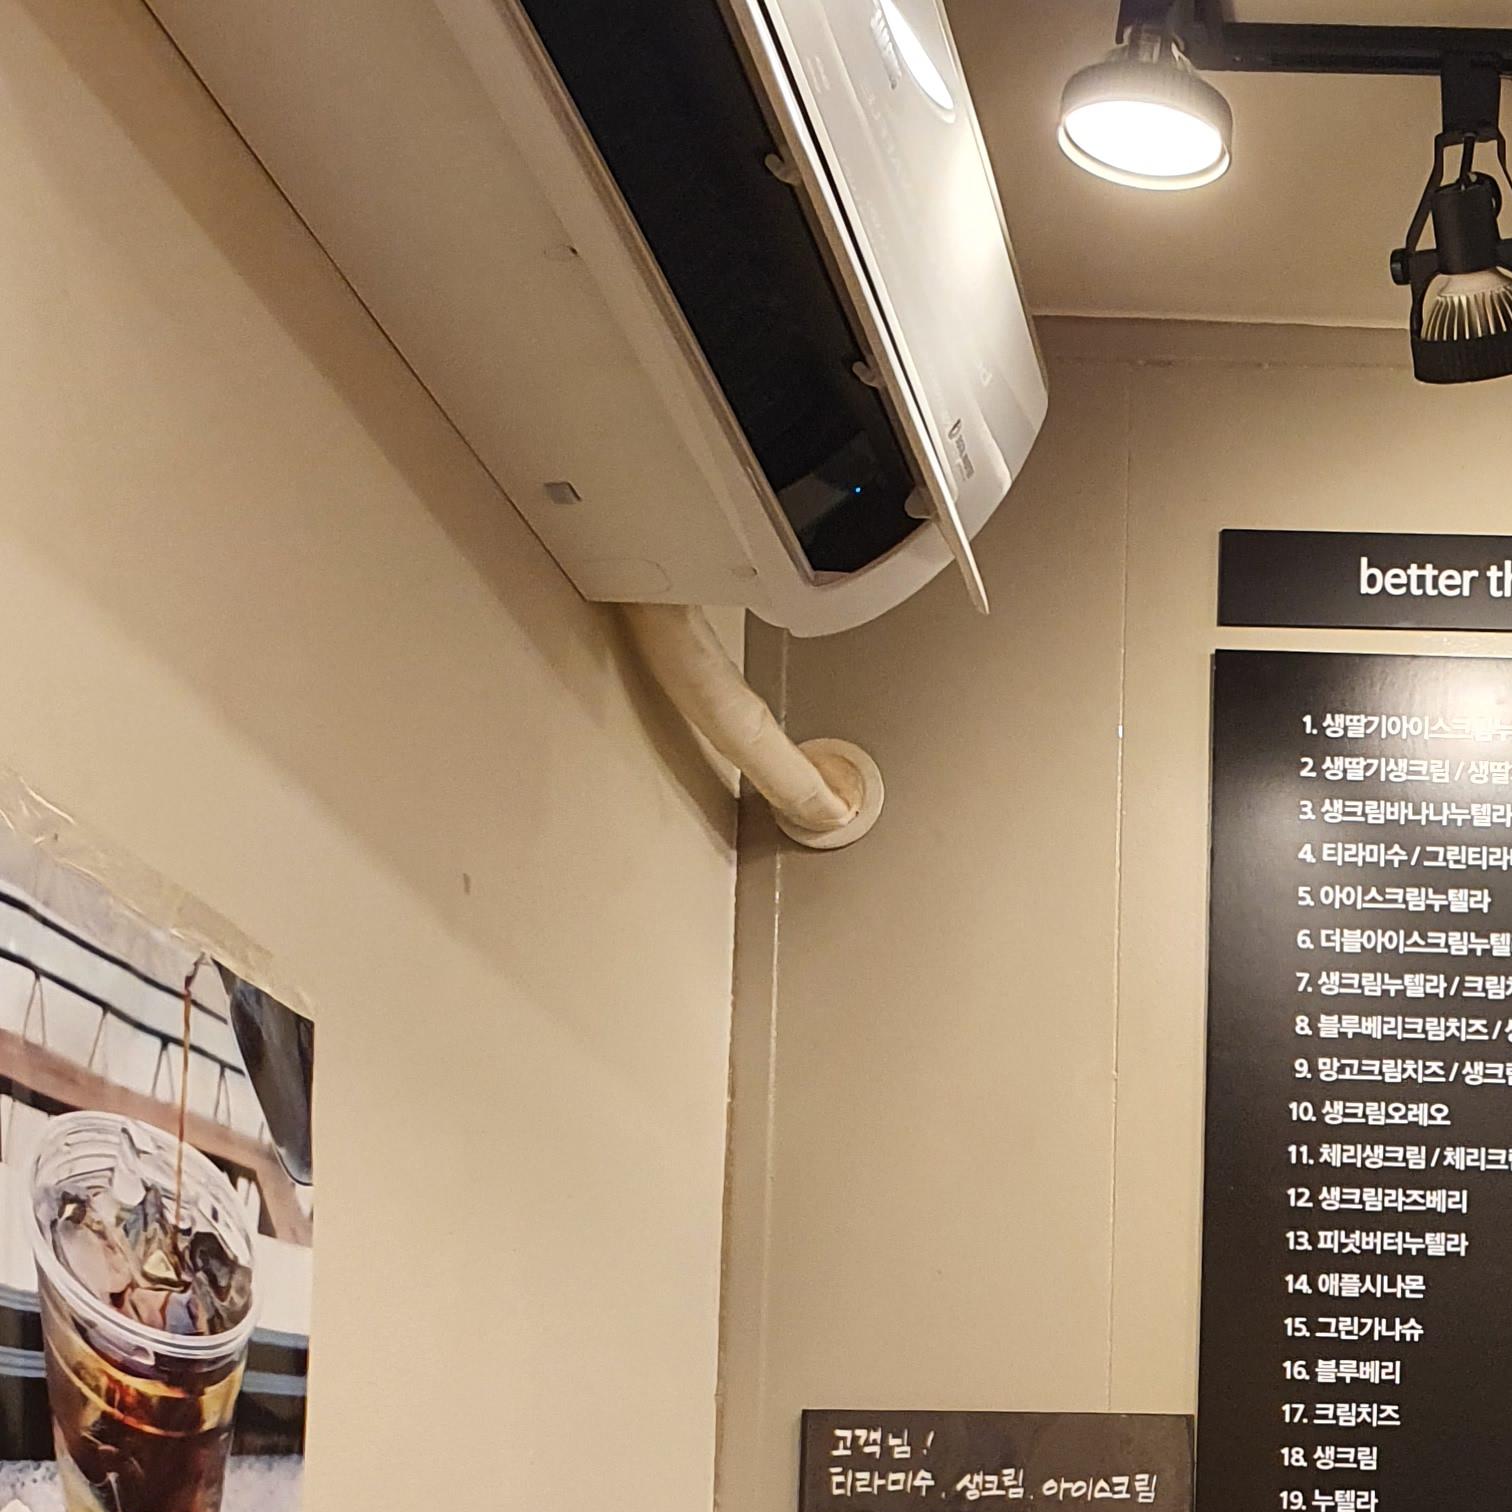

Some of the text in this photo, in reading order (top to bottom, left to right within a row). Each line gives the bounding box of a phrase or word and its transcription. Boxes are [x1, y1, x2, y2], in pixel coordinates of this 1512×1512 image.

[1360, 556, 1479, 597] better
[1321, 756, 1450, 783] 생딸기생크림
[1321, 842, 1409, 868] 티라미수
[1319, 884, 1492, 914] 아이스크림누텔라
[1317, 971, 1448, 999] 생크림누텔라
[1317, 1014, 1489, 1042] 블루베리크림치즈
[1317, 1057, 1447, 1084] 망고크림치즈
[1321, 1100, 1451, 1127] 생크림오레오
[1319, 1143, 1426, 1170] 체리생크림
[1318, 1186, 1468, 1214] 생크림라즈베리
[1317, 1229, 1469, 1257] 피넛버터누텔라
[1317, 1273, 1426, 1299] 애플시나몬
[1315, 1316, 1424, 1342] 그린가나슈
[1314, 1359, 1401, 1385] 블루베리
[1313, 1402, 1401, 1427] 크림치즈
[1312, 1445, 1378, 1471] 생크림
[1042, 1474, 1157, 1502] 아이스크림
